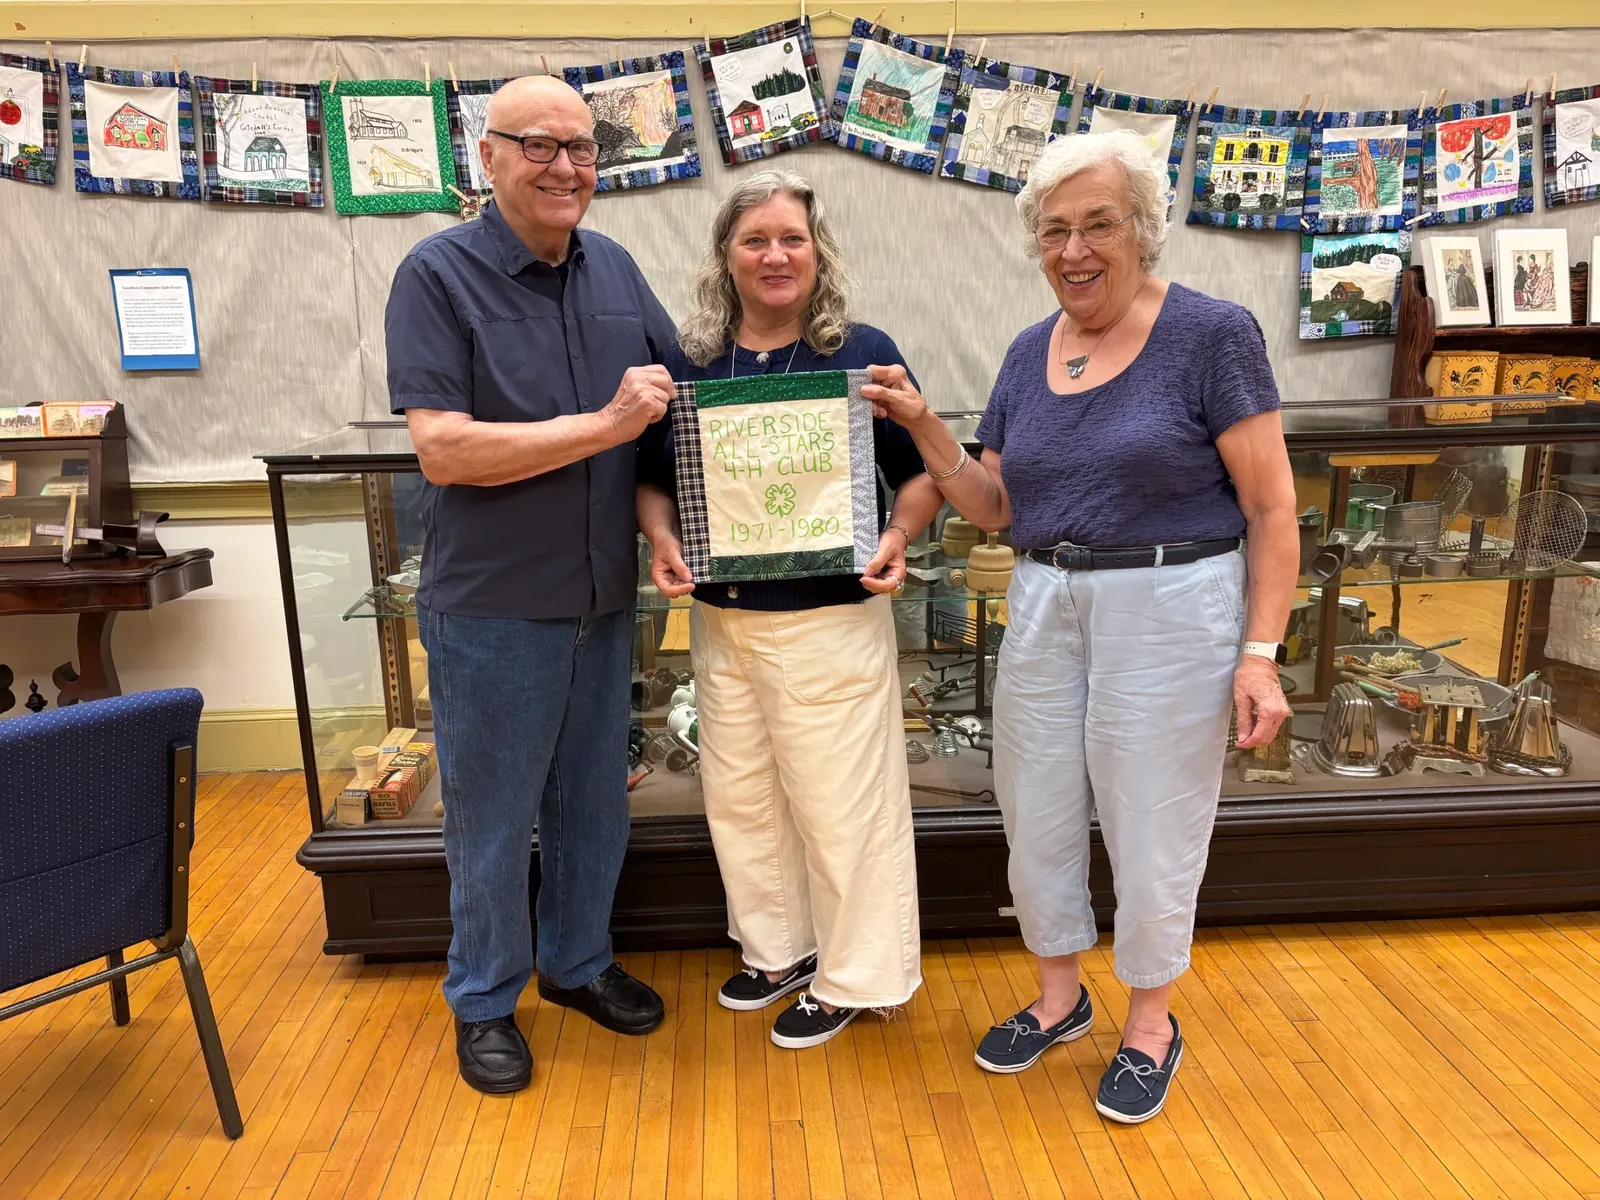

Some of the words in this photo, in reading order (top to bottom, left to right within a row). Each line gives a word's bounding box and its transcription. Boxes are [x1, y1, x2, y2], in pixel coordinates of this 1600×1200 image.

[709, 411, 833, 440] RIVERSIDE
[713, 432, 835, 460] ALL-STARS
[724, 460, 762, 480] 4-H
[778, 452, 833, 476] CLUB
[731, 516, 840, 542] 1971-1980
